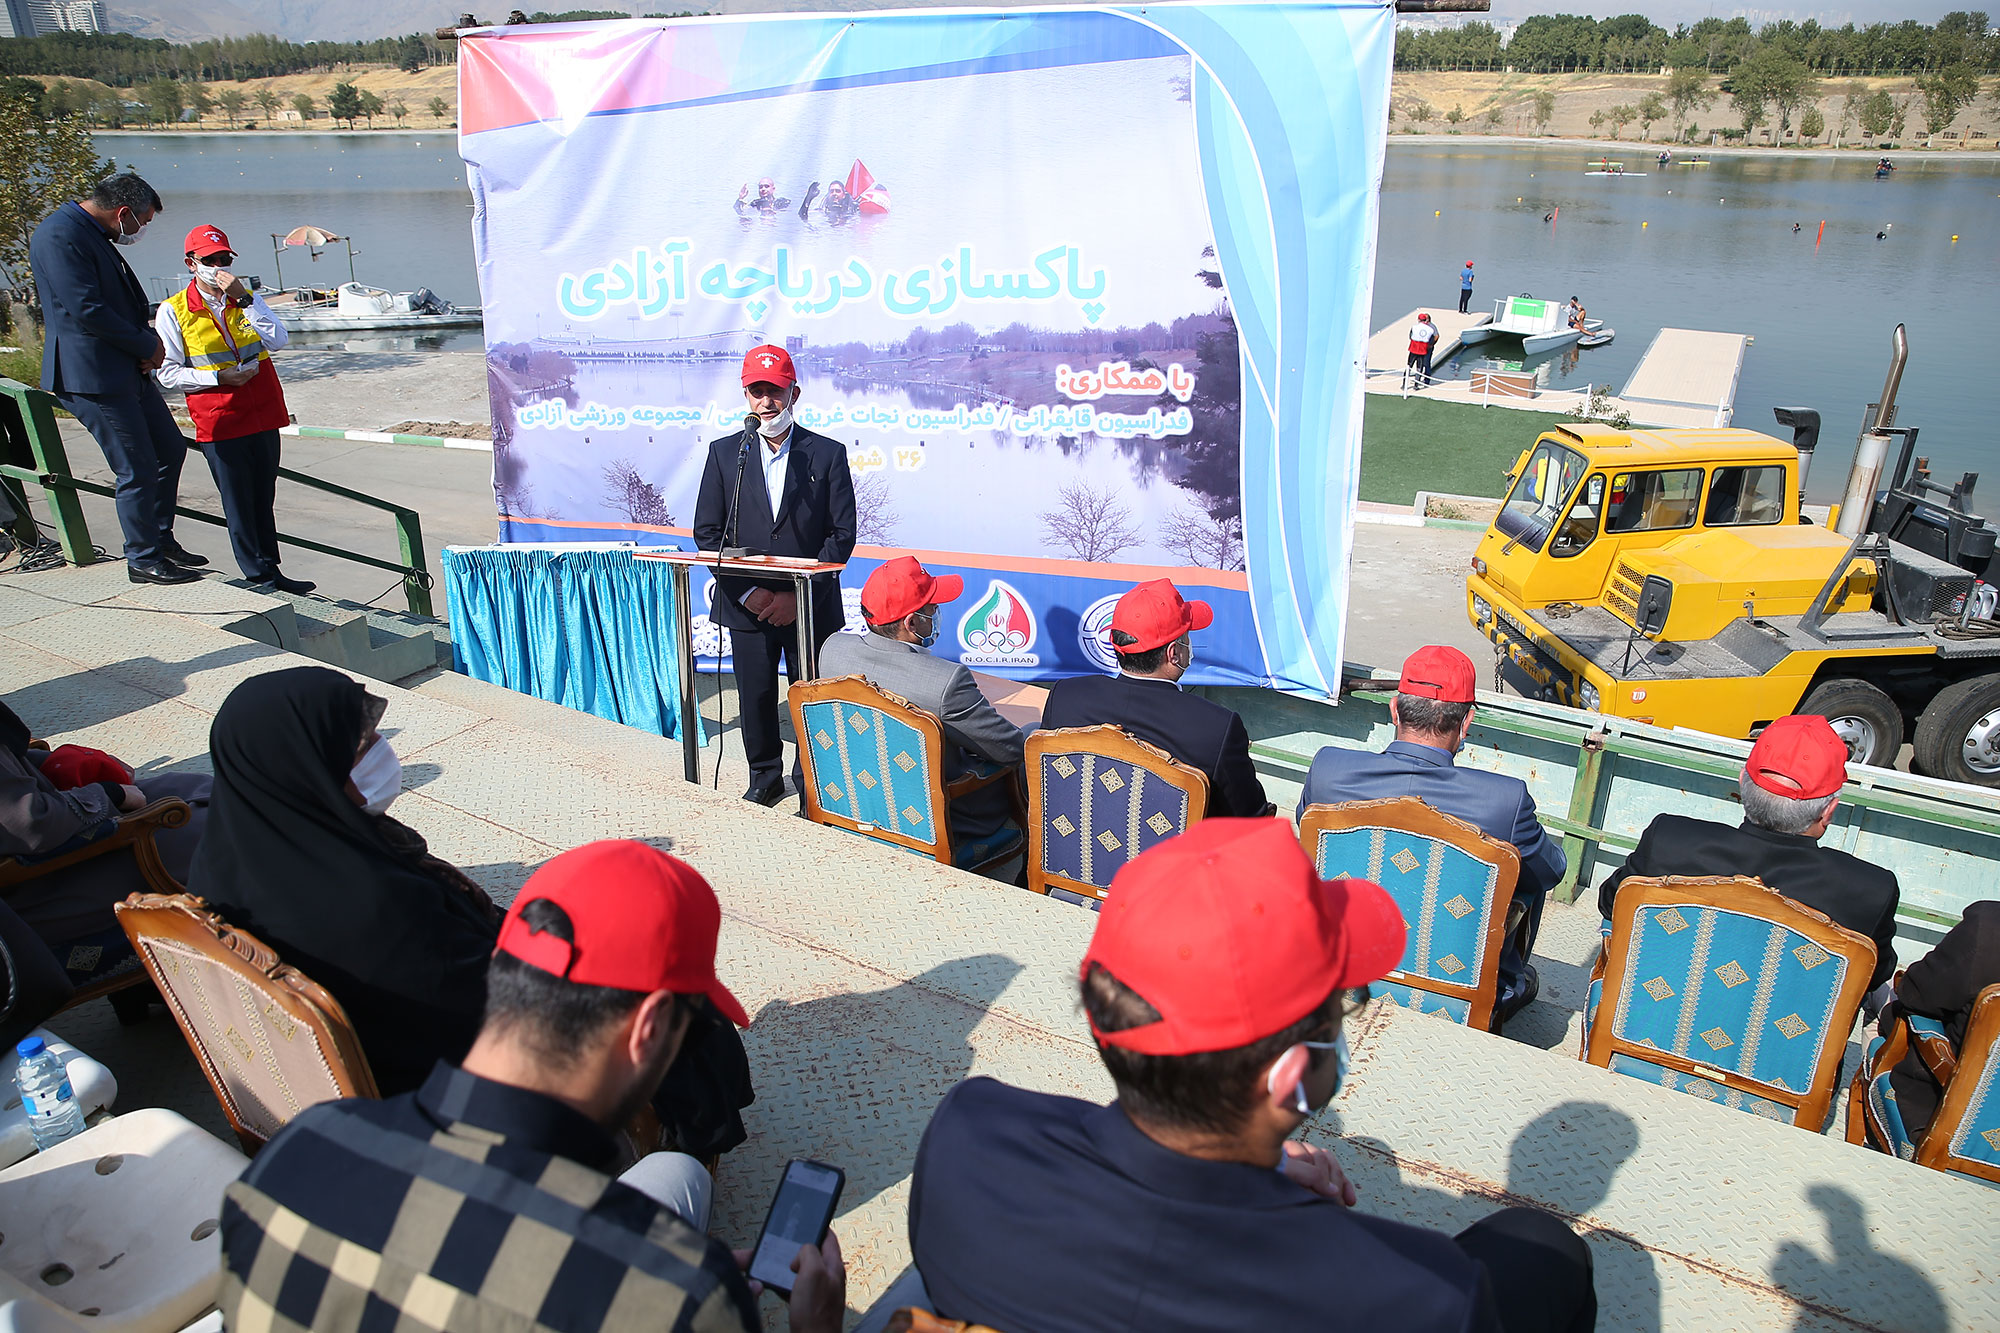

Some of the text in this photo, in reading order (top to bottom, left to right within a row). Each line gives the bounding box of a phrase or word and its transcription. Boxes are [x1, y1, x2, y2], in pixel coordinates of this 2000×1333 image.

[560, 241, 1106, 325] پاکسازی دریاچه آزادی
[1060, 366, 1190, 398] با همکاری:
[519, 402, 563, 425] آزادی
[569, 405, 627, 427] ورزشی
[632, 408, 702, 427] مجموعه
[799, 406, 844, 428] غریق
[850, 406, 899, 429] نجات
[905, 407, 994, 430] فدراسیون
[1014, 407, 1092, 432] قایقرانی
[1098, 411, 1189, 435] فدراسیون
[896, 450, 921, 468] ۲۶
[965, 656, 1034, 664] N.O.C.I.R.IRAN
[1632, 691, 1646, 700] UD
